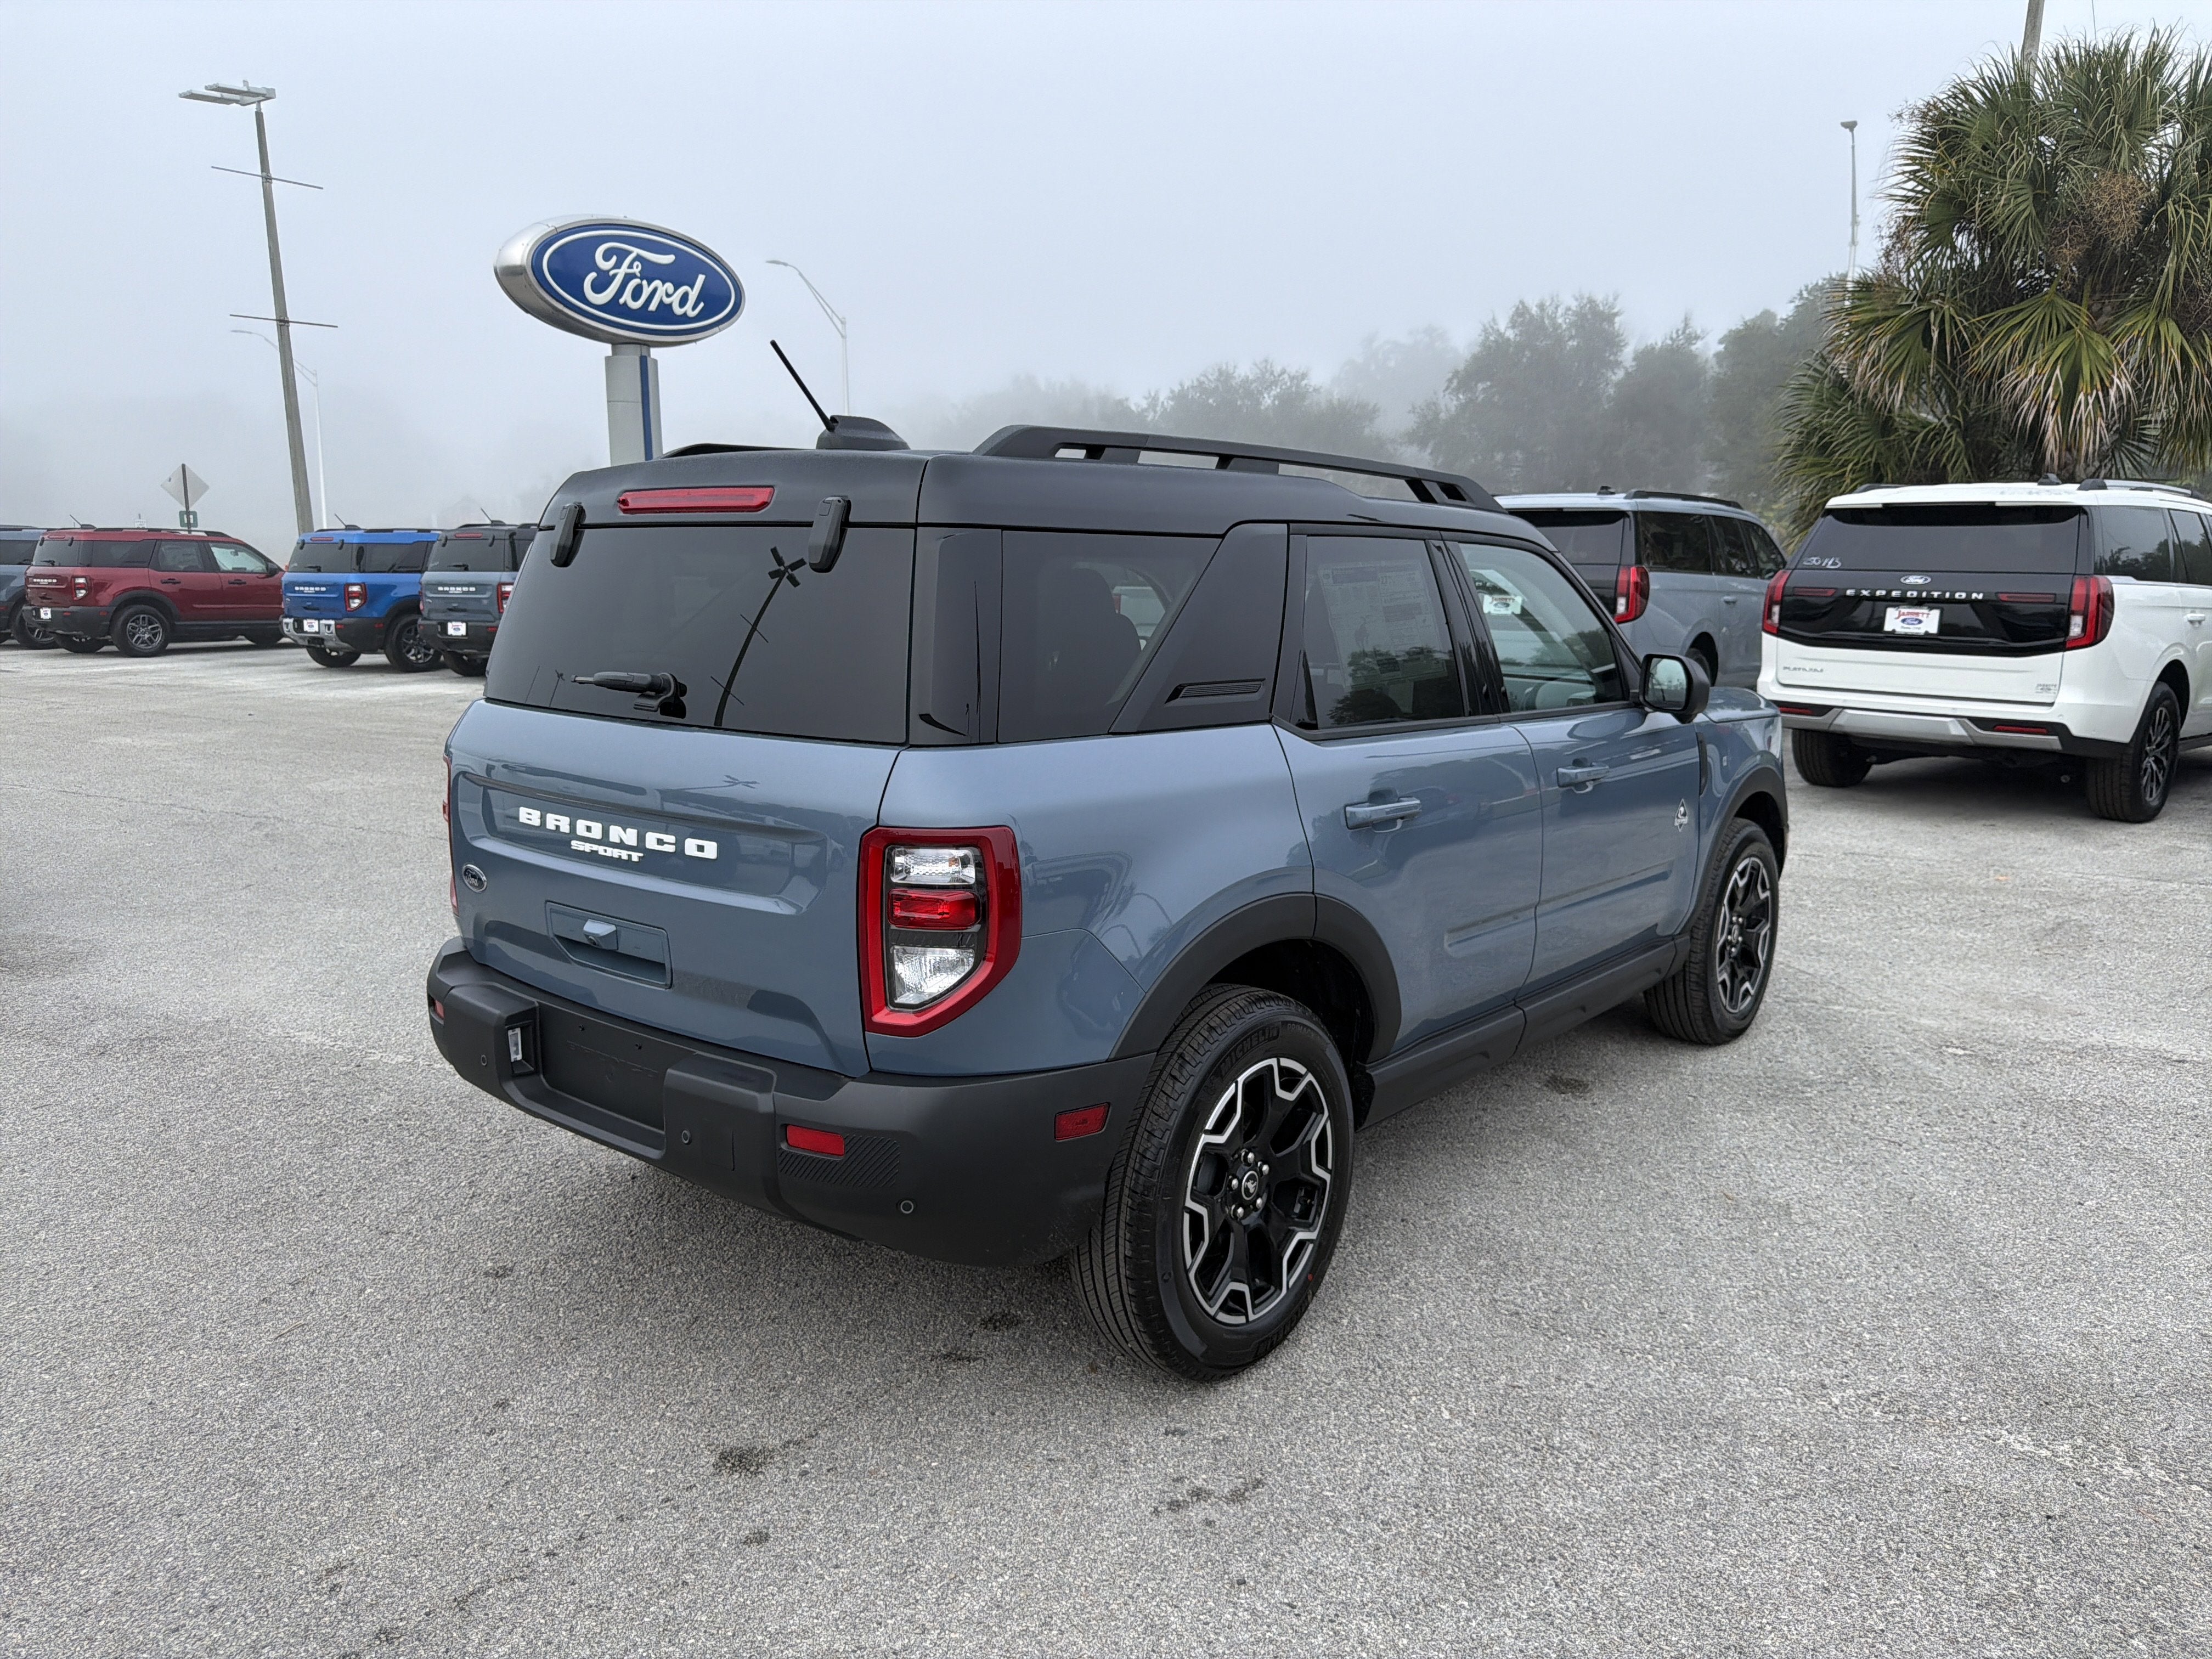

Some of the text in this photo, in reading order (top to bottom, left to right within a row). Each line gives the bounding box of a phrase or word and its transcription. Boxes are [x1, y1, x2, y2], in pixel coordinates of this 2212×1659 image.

[583, 242, 706, 318] Ford
[1846, 589, 1984, 600] EXPEDITION
[518, 806, 718, 860] BRONCO
[571, 839, 644, 862] SPORT
[1219, 1025, 1279, 1081] MICHELIN
